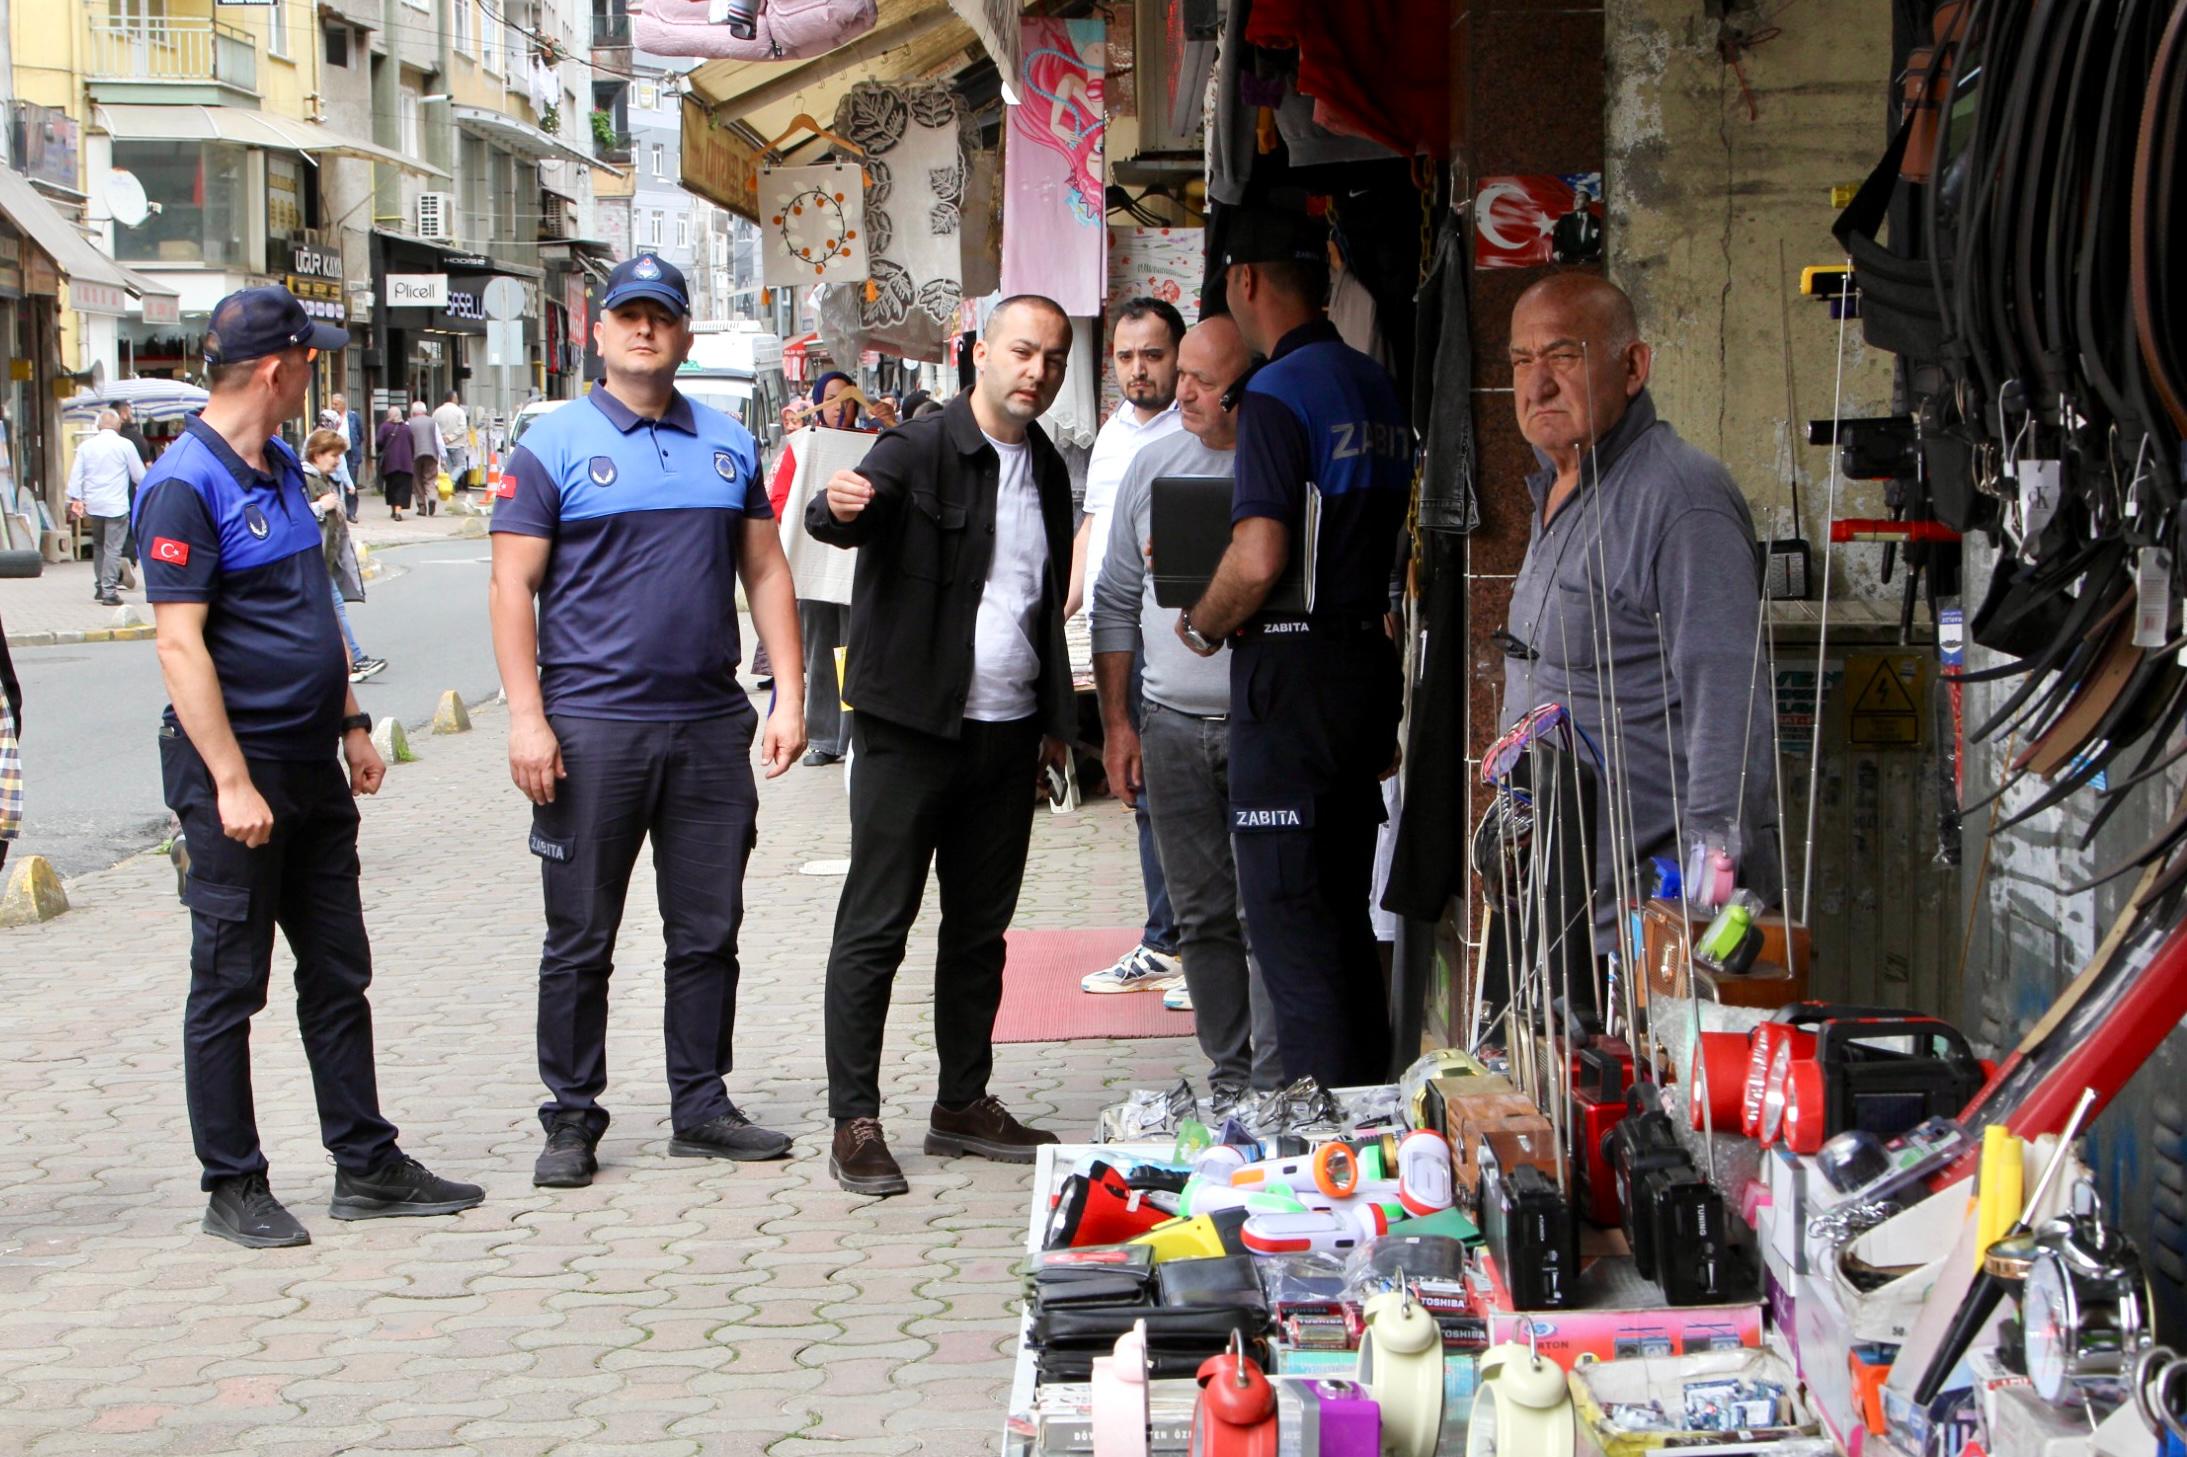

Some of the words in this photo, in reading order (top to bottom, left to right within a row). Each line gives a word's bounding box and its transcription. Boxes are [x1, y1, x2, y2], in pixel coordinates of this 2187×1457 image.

[295, 246, 321, 275] UĞUR
[394, 282, 435, 299] Plicell
[1264, 622, 1310, 633] ZABITA
[1236, 810, 1300, 826] ZABITA
[530, 836, 564, 860] ZABITA
[1697, 1203, 1707, 1237] TUNING
[1421, 1297, 1465, 1308] TOSHIBA
